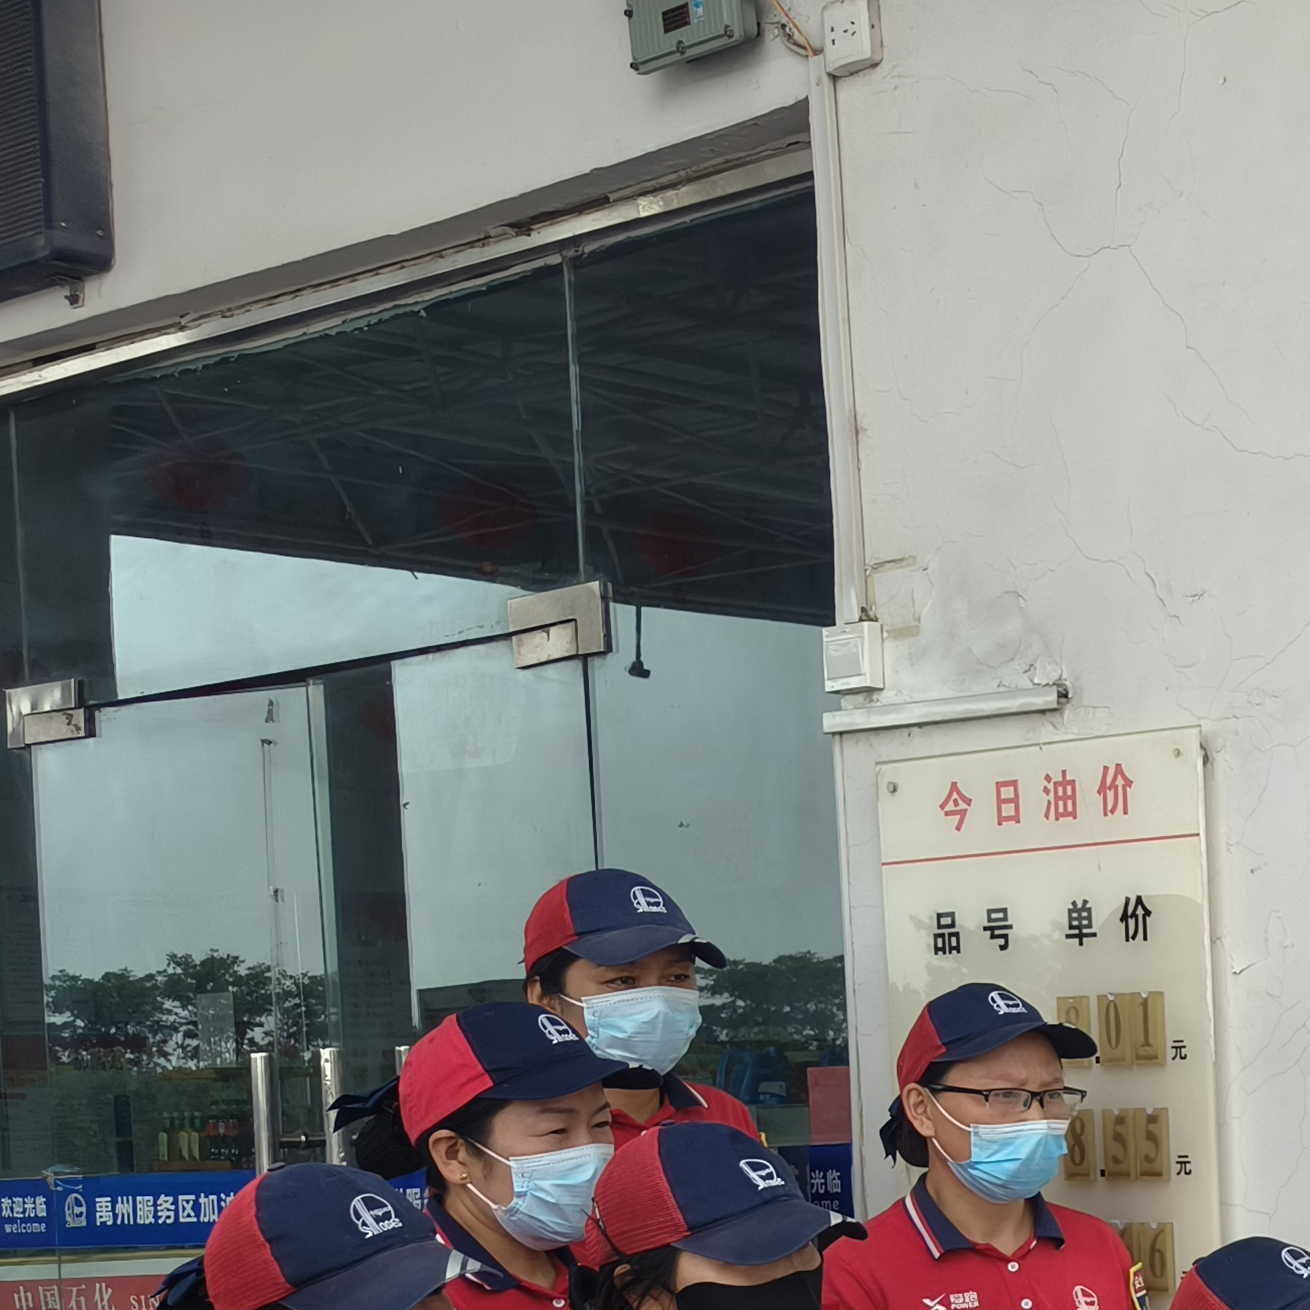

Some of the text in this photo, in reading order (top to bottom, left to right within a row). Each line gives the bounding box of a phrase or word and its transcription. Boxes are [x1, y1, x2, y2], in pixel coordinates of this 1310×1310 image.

[938, 762, 1134, 833] 今日油价
[932, 894, 1153, 956] 品号 单价
[1170, 1039, 1188, 1061] 元
[1175, 1154, 1193, 1176] 元
[0, 1194, 48, 1219] 欢迎光临
[3, 1218, 47, 1234] welcome
